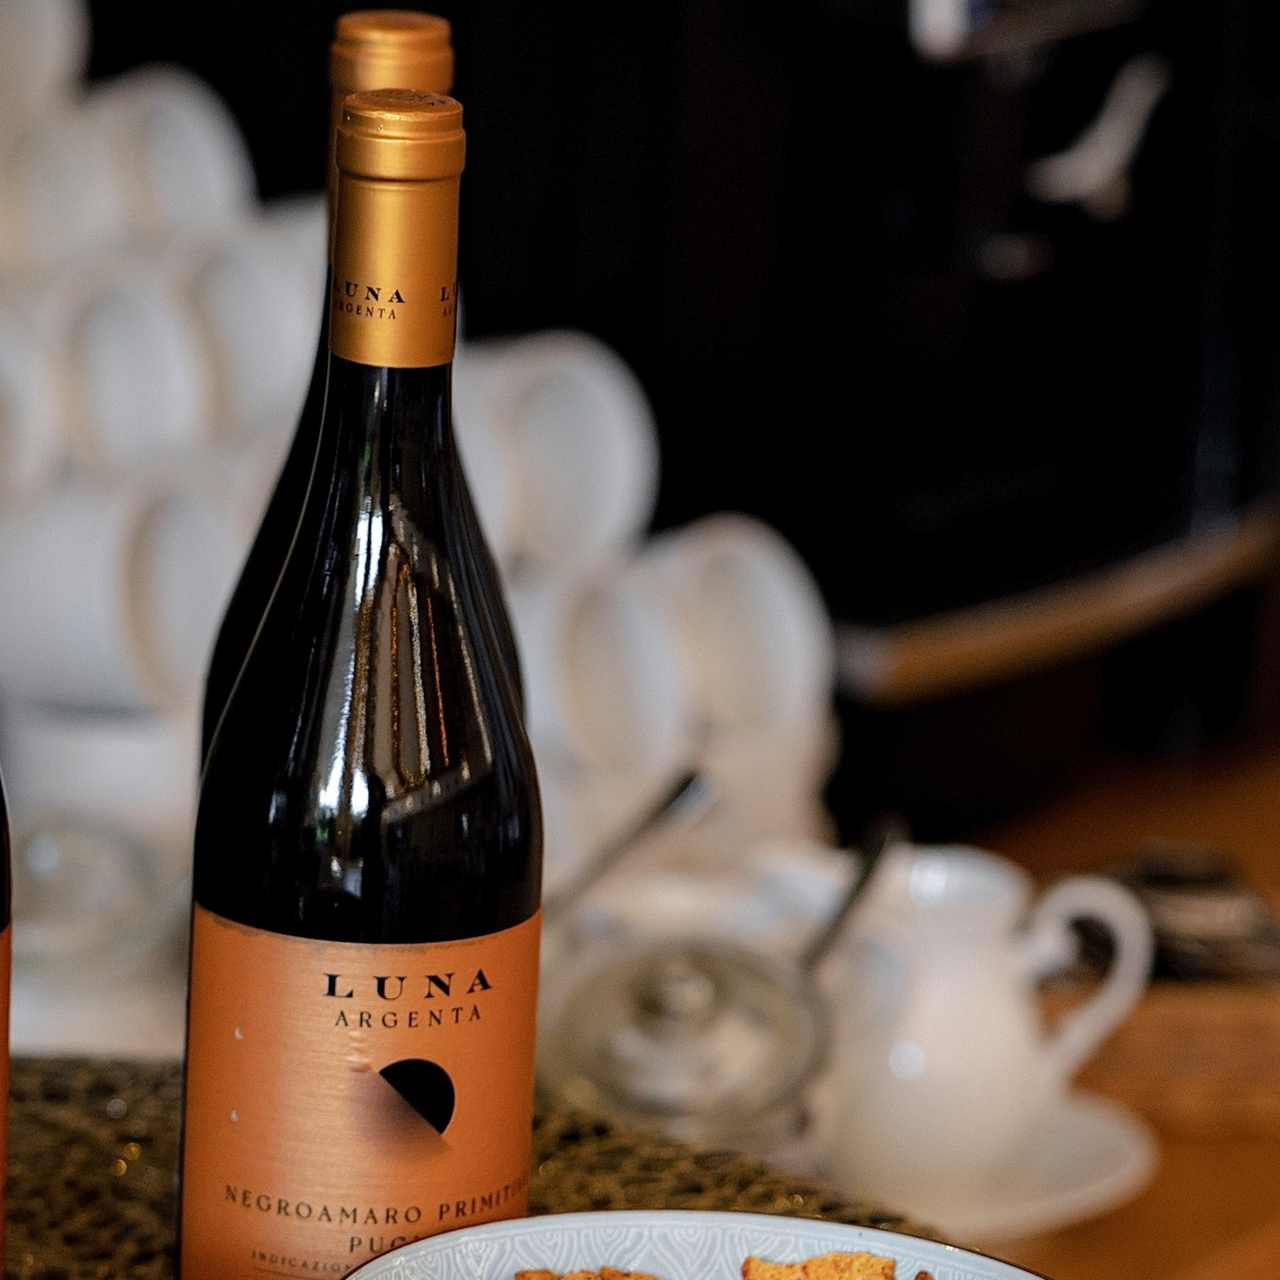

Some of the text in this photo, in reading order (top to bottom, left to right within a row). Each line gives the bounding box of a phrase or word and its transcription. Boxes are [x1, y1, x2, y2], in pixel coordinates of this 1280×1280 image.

[333, 276, 405, 304] LUNA
[324, 968, 493, 1001] LUNA
[335, 1004, 481, 1029] ARGENTA
[224, 1183, 422, 1224] NEGROAMARO
[251, 1250, 353, 1273] INDICAZION
